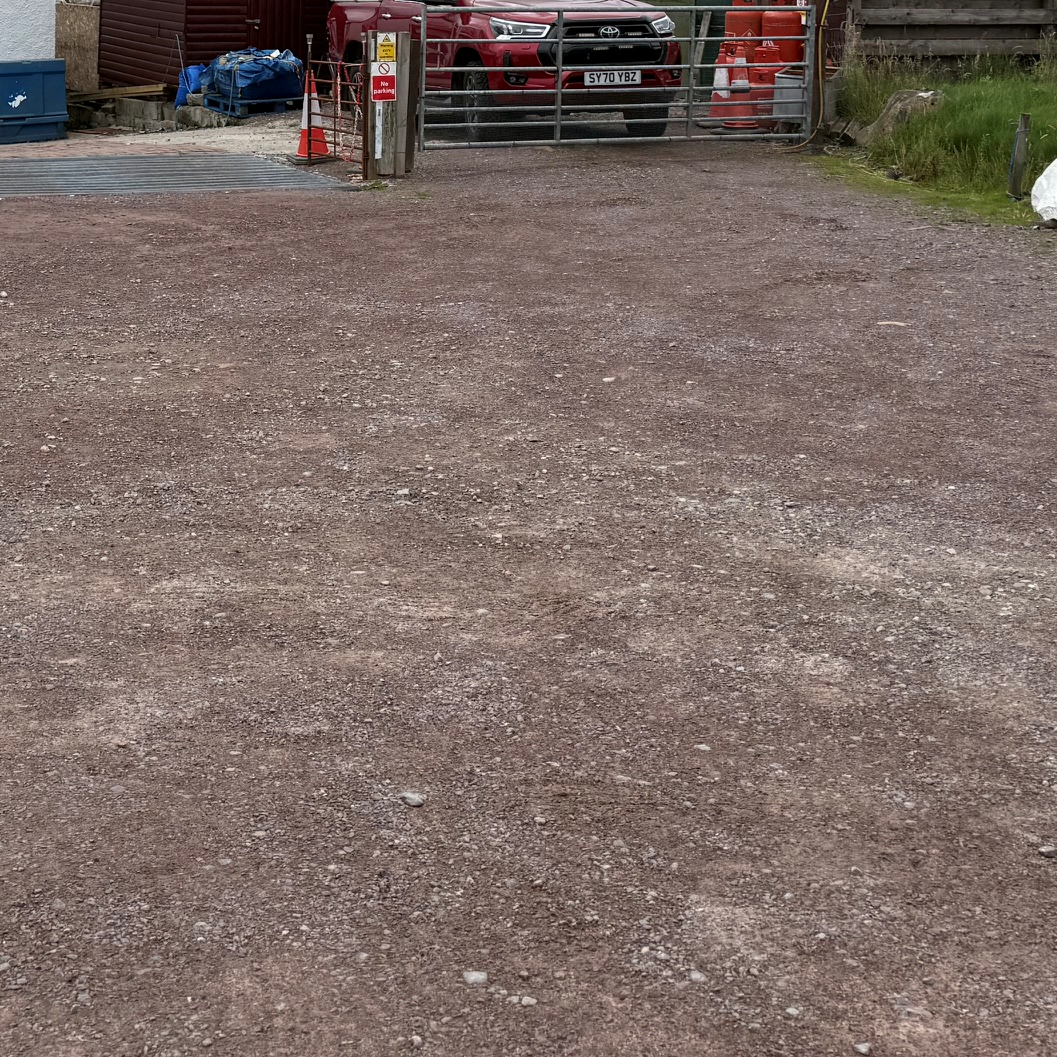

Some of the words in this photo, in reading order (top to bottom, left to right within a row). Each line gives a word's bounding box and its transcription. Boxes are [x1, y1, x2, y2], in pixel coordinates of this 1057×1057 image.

[589, 72, 615, 83] SY70
[617, 71, 637, 83] YBZ
[373, 87, 395, 95] parking
